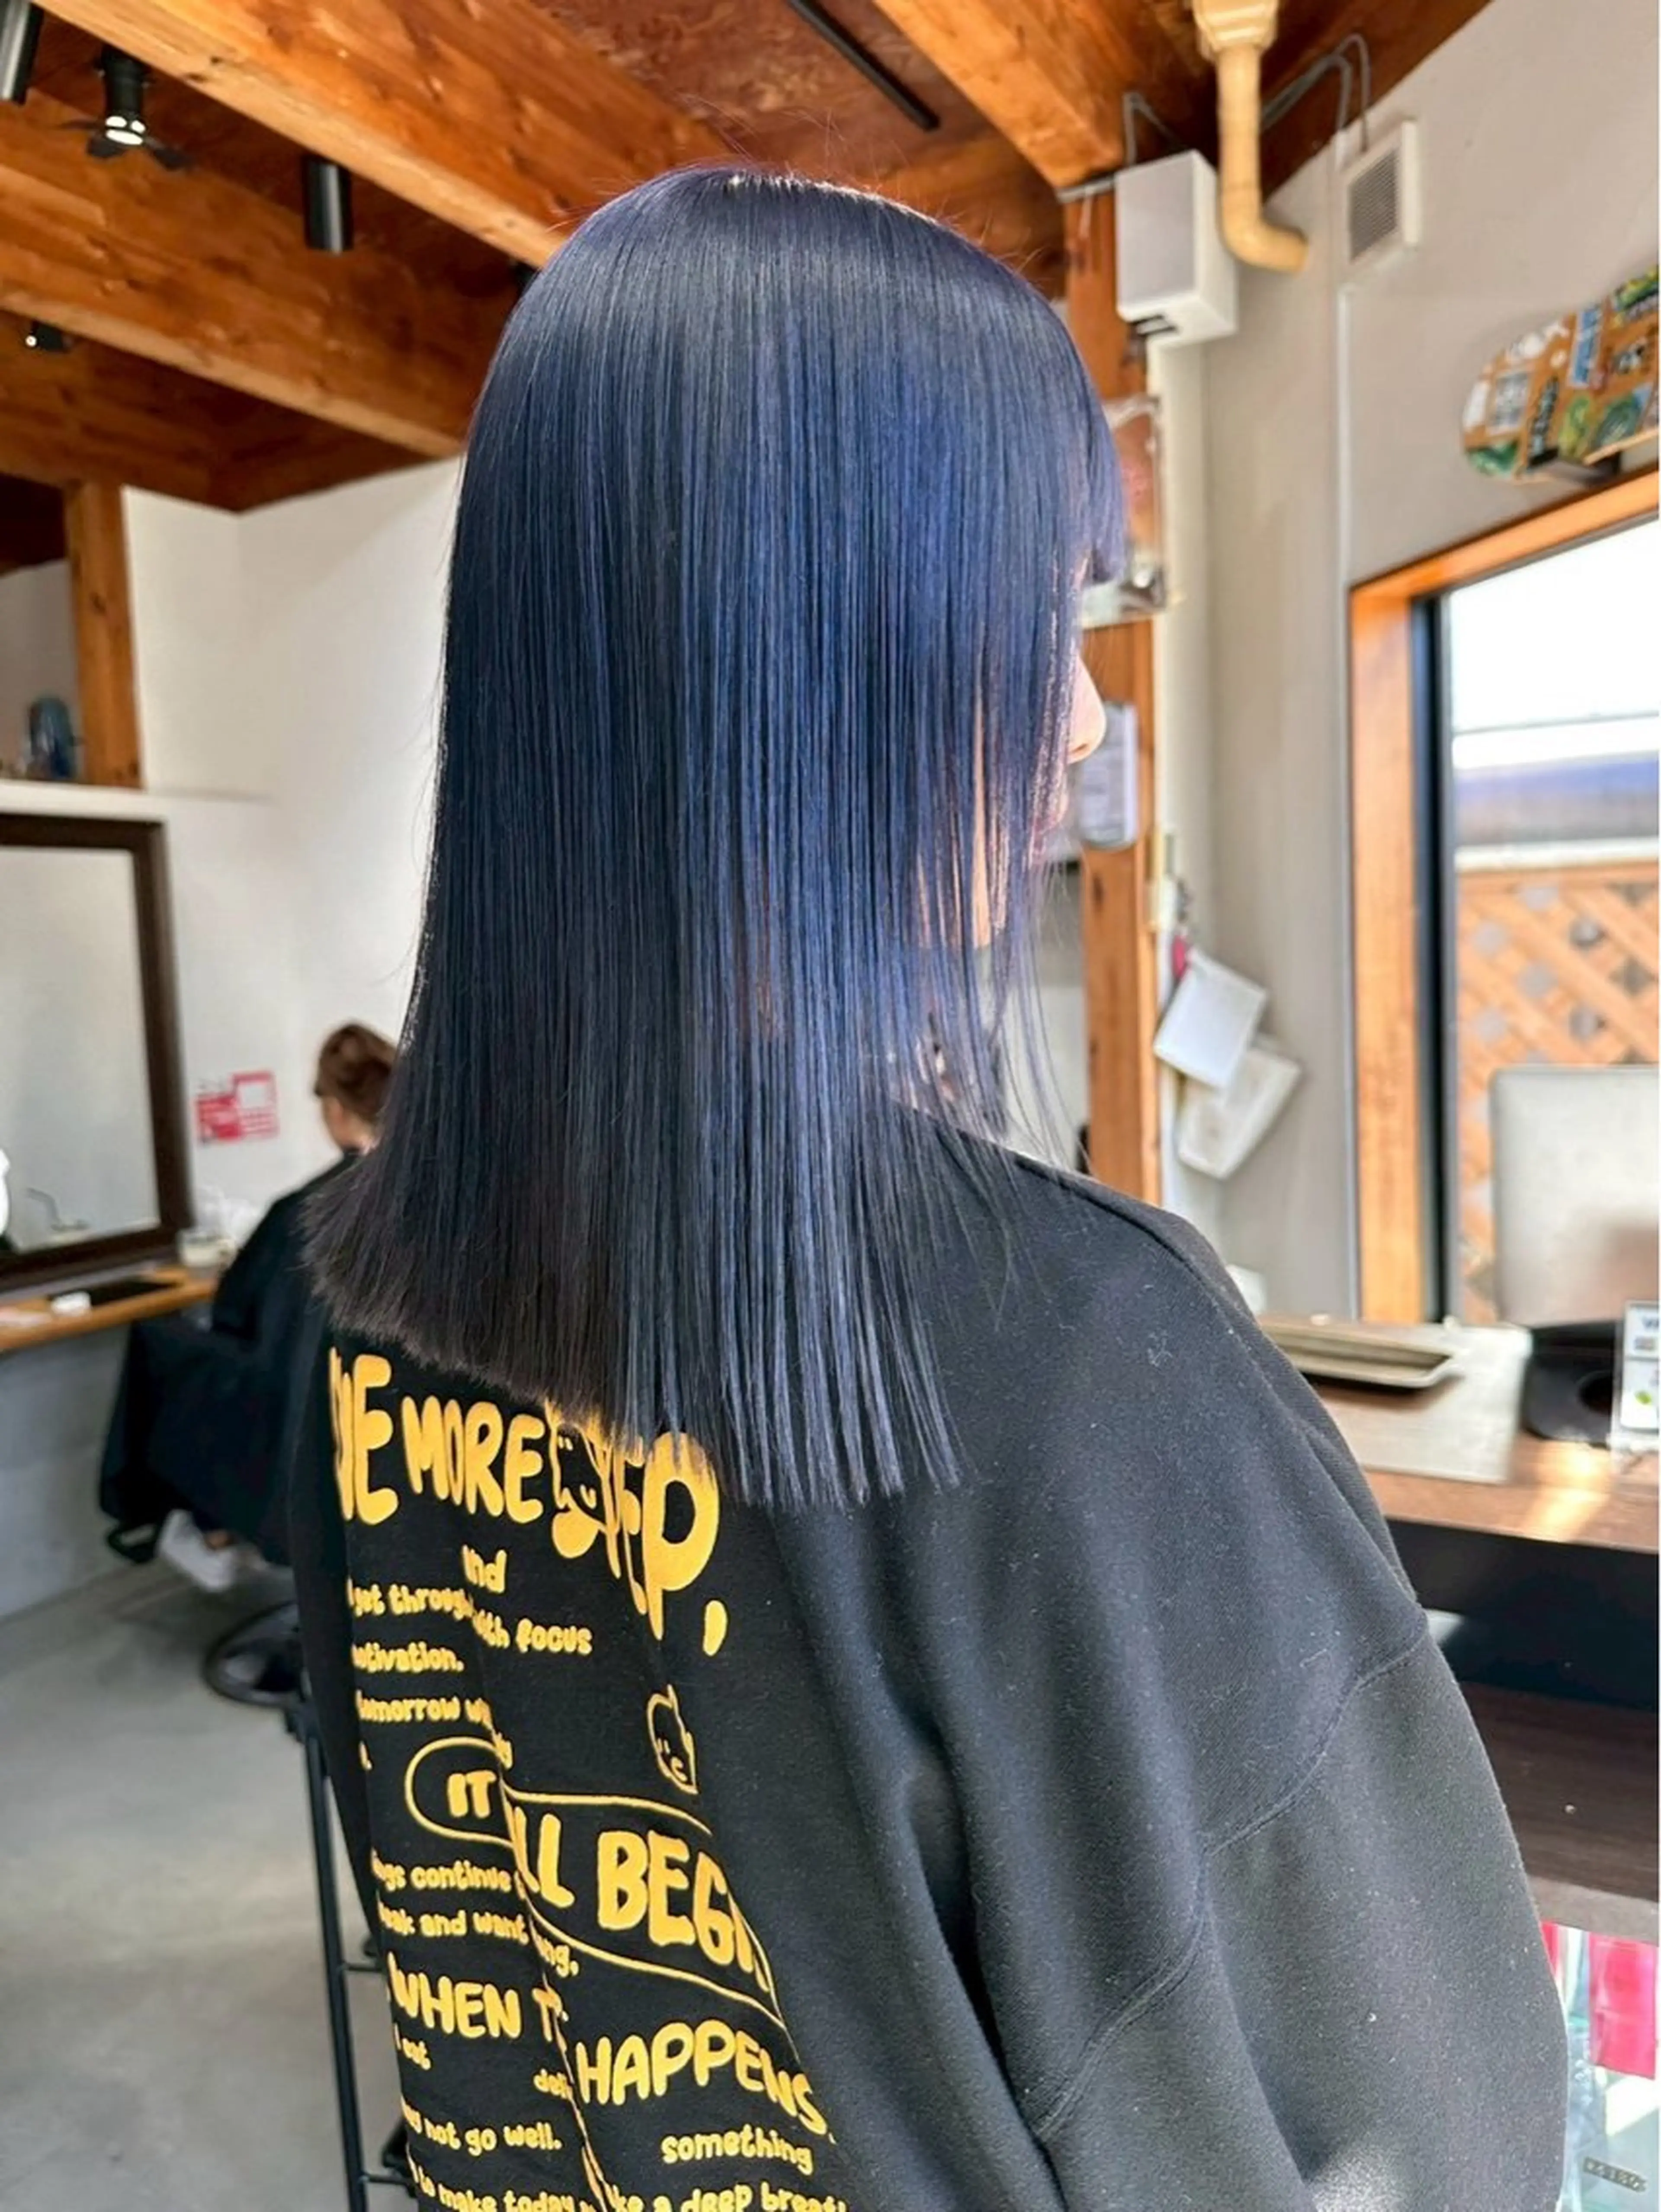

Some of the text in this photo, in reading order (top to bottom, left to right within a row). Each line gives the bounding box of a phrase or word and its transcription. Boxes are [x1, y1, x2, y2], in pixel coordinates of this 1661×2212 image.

[401, 1395, 544, 1523] MORE
[516, 1618, 593, 1655] focus
[447, 1770, 497, 1818] IT
[410, 1860, 511, 1892] continue
[388, 1952, 521, 2039] WHEN
[465, 2128, 497, 2157] go
[503, 2121, 562, 2150] well.
[661, 2123, 814, 2176] something
